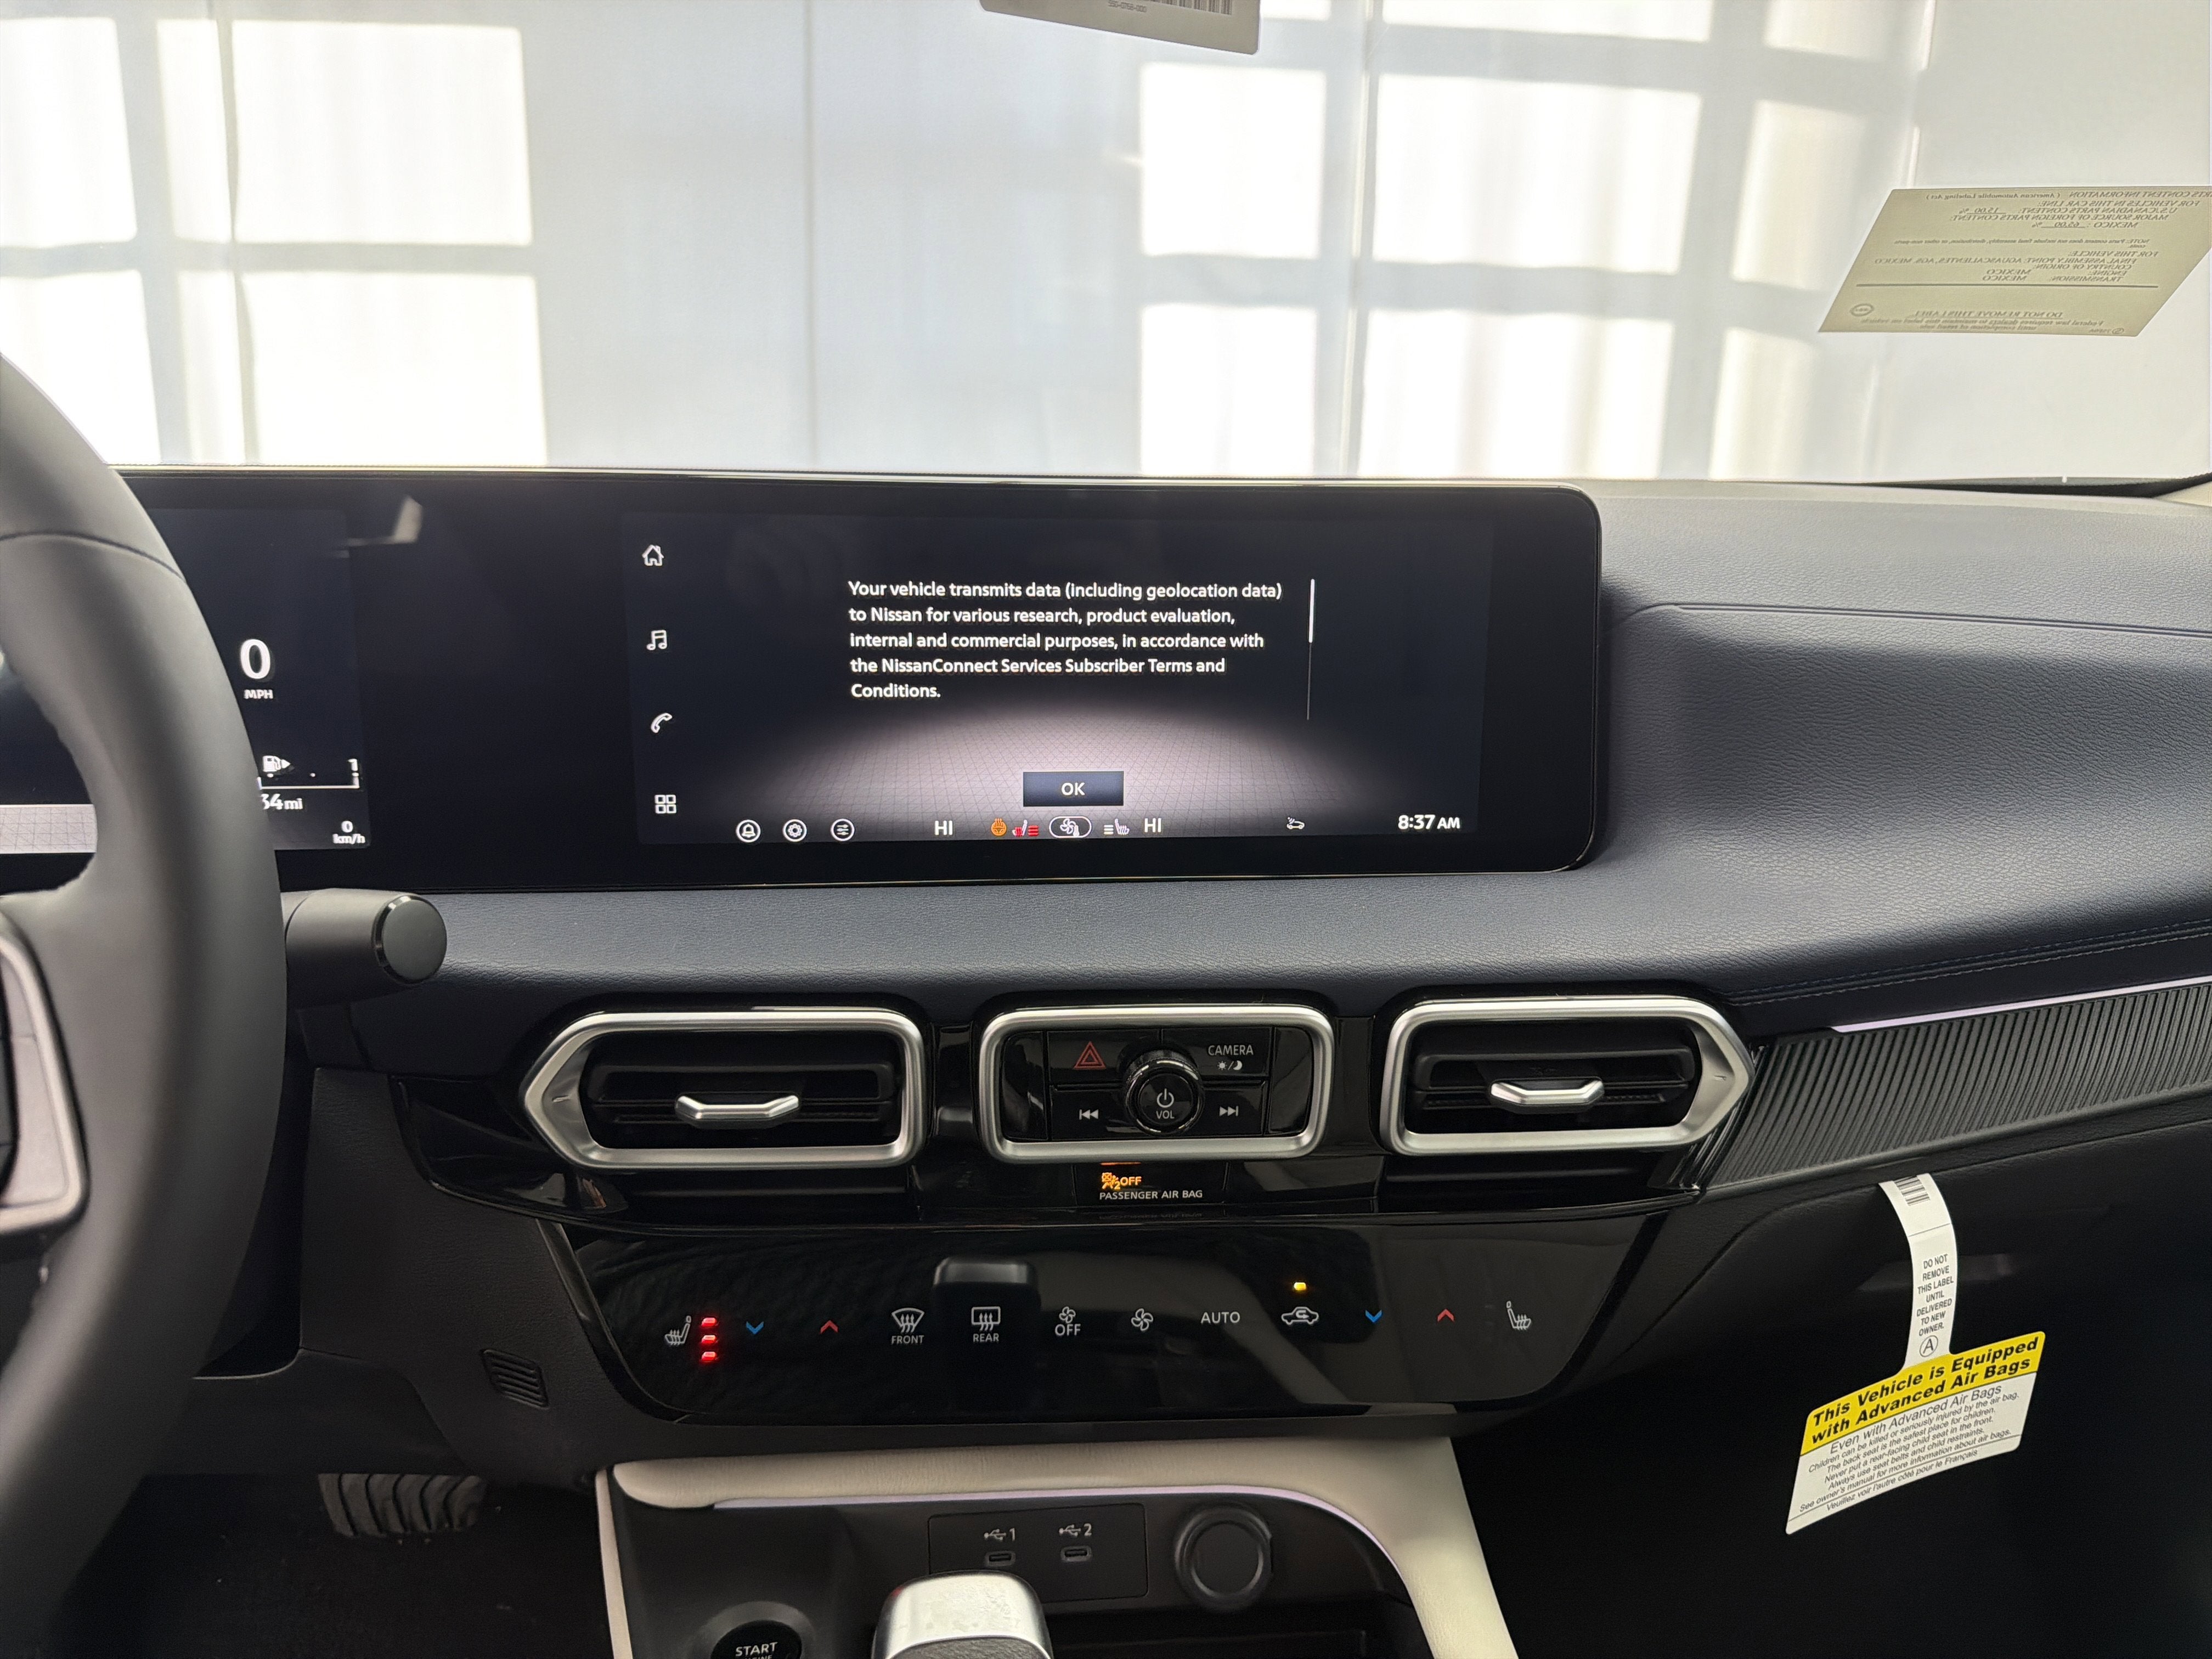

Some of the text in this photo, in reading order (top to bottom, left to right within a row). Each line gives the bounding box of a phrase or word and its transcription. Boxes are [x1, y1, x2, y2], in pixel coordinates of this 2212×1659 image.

[848, 581, 1282, 601] Your vehicle transmits data (including geolocation data)
[849, 607, 1234, 626] to Nissan for various research, product evaluation,
[850, 633, 1263, 651] internal and commercial purposes, in accordance with
[240, 639, 271, 679] 0
[850, 658, 1224, 672] the NissanConnect Services Subscriber Terms and
[244, 689, 273, 699] MPH
[851, 683, 940, 697] Conditions.
[1061, 782, 1085, 795] OK
[284, 798, 303, 810] mi
[341, 820, 353, 833] 0
[934, 820, 953, 836] HI
[1144, 819, 1162, 833] HI
[1398, 814, 1460, 830] 8:37 AM
[332, 833, 366, 845] km/h
[1208, 1045, 1254, 1056] CAMERA
[1156, 1110, 1175, 1119] VOL
[1120, 1176, 1142, 1186] OFF
[1099, 1190, 1203, 1200] PASSENGER AIR BAG
[1923, 1254, 1948, 1269] DO NOT
[1922, 1265, 1949, 1282] REMOVE
[1917, 1276, 1954, 1294] THIS LABEL
[1926, 1290, 1944, 1303] UNTIL
[1917, 1298, 1953, 1317] DELIVERED
[1200, 1311, 1240, 1324] AUTO
[1921, 1311, 1946, 1325] TO NEW
[1054, 1323, 1081, 1336] OFF
[1918, 1322, 1944, 1336] OWNER.
[891, 1335, 924, 1344] FRONT
[973, 1333, 999, 1342] REAR
[1813, 1336, 2039, 1426] This Vehicle is Equipped
[1812, 1358, 2030, 1444] with Advanced Air Bags
[1830, 1385, 2001, 1454] Even with Advanced Air Bags
[1808, 1392, 2019, 1473] Children can be killed or seriously injured by the air bag.
[1827, 1407, 1995, 1474] The back seat is the safest place for children.
[1825, 1469, 1848, 1483] Never
[1849, 1462, 1861, 1474] put
[1870, 1443, 1910, 1463] rear-facing
[1911, 1435, 1930, 1448] child
[1932, 1428, 1949, 1440] seat
[1959, 1422, 1972, 1432] the
[1973, 1416, 1993, 1428] front.
[1828, 1428, 1984, 1490] Always use seat belts and child restraints.
[1799, 1429, 2011, 1513] See owner's manual for more information about air bags.
[1826, 1494, 1856, 1511] Veuillez
[1858, 1487, 1872, 1498] voir
[1873, 1476, 1896, 1492] l'autre
[1916, 1464, 1935, 1477] pour
[1936, 1460, 1943, 1469] le
[1009, 1527, 1016, 1541] 1
[1084, 1523, 1092, 1537] 2
[735, 1641, 778, 1657] START
